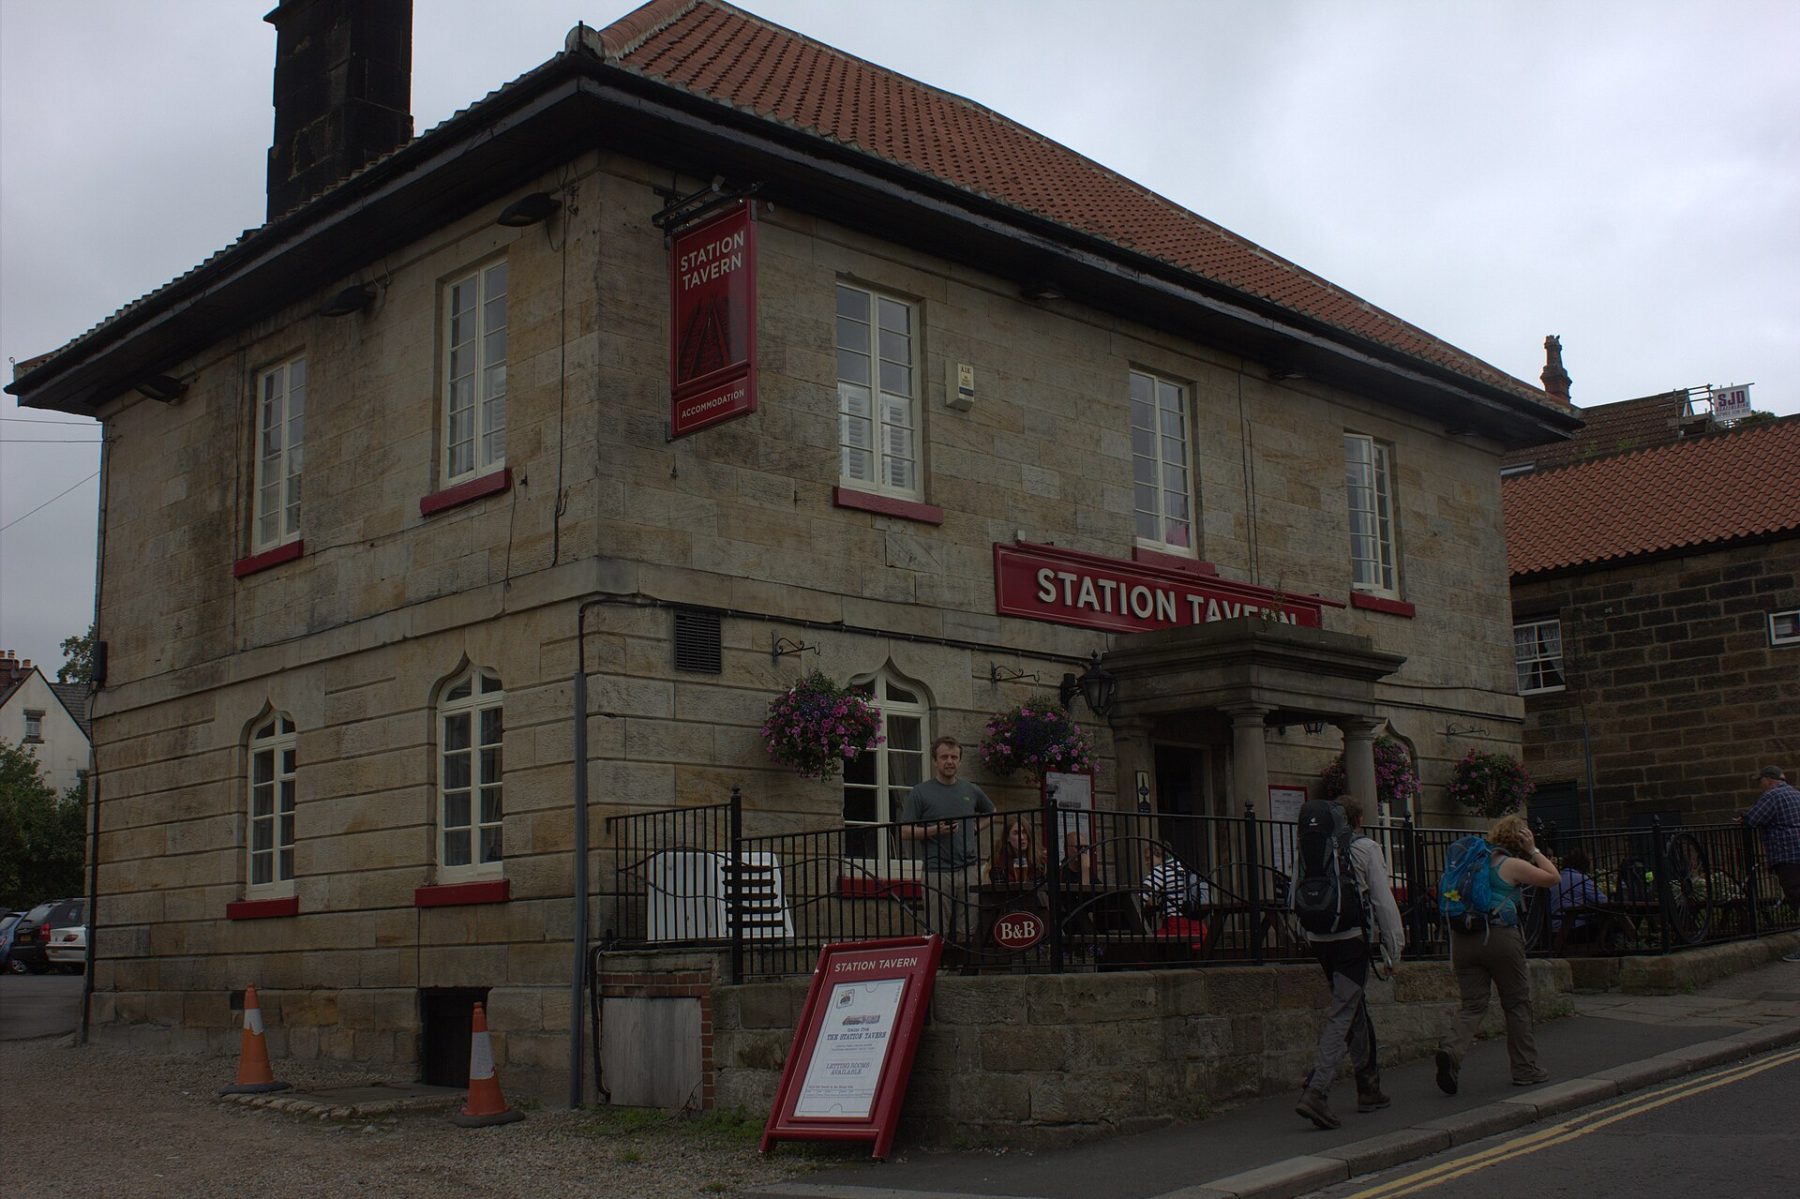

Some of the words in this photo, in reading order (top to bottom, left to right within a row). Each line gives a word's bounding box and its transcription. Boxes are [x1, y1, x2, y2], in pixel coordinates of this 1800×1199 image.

[680, 230, 745, 272] STATION
[682, 253, 743, 291] TAVERN
[681, 388, 745, 419] ACCOMMODATION
[1718, 391, 1745, 406] SJD
[1036, 567, 1177, 623] STATION
[1000, 921, 1035, 940] B&B
[835, 961, 876, 972] STATION
[879, 958, 918, 969] TAVERN
